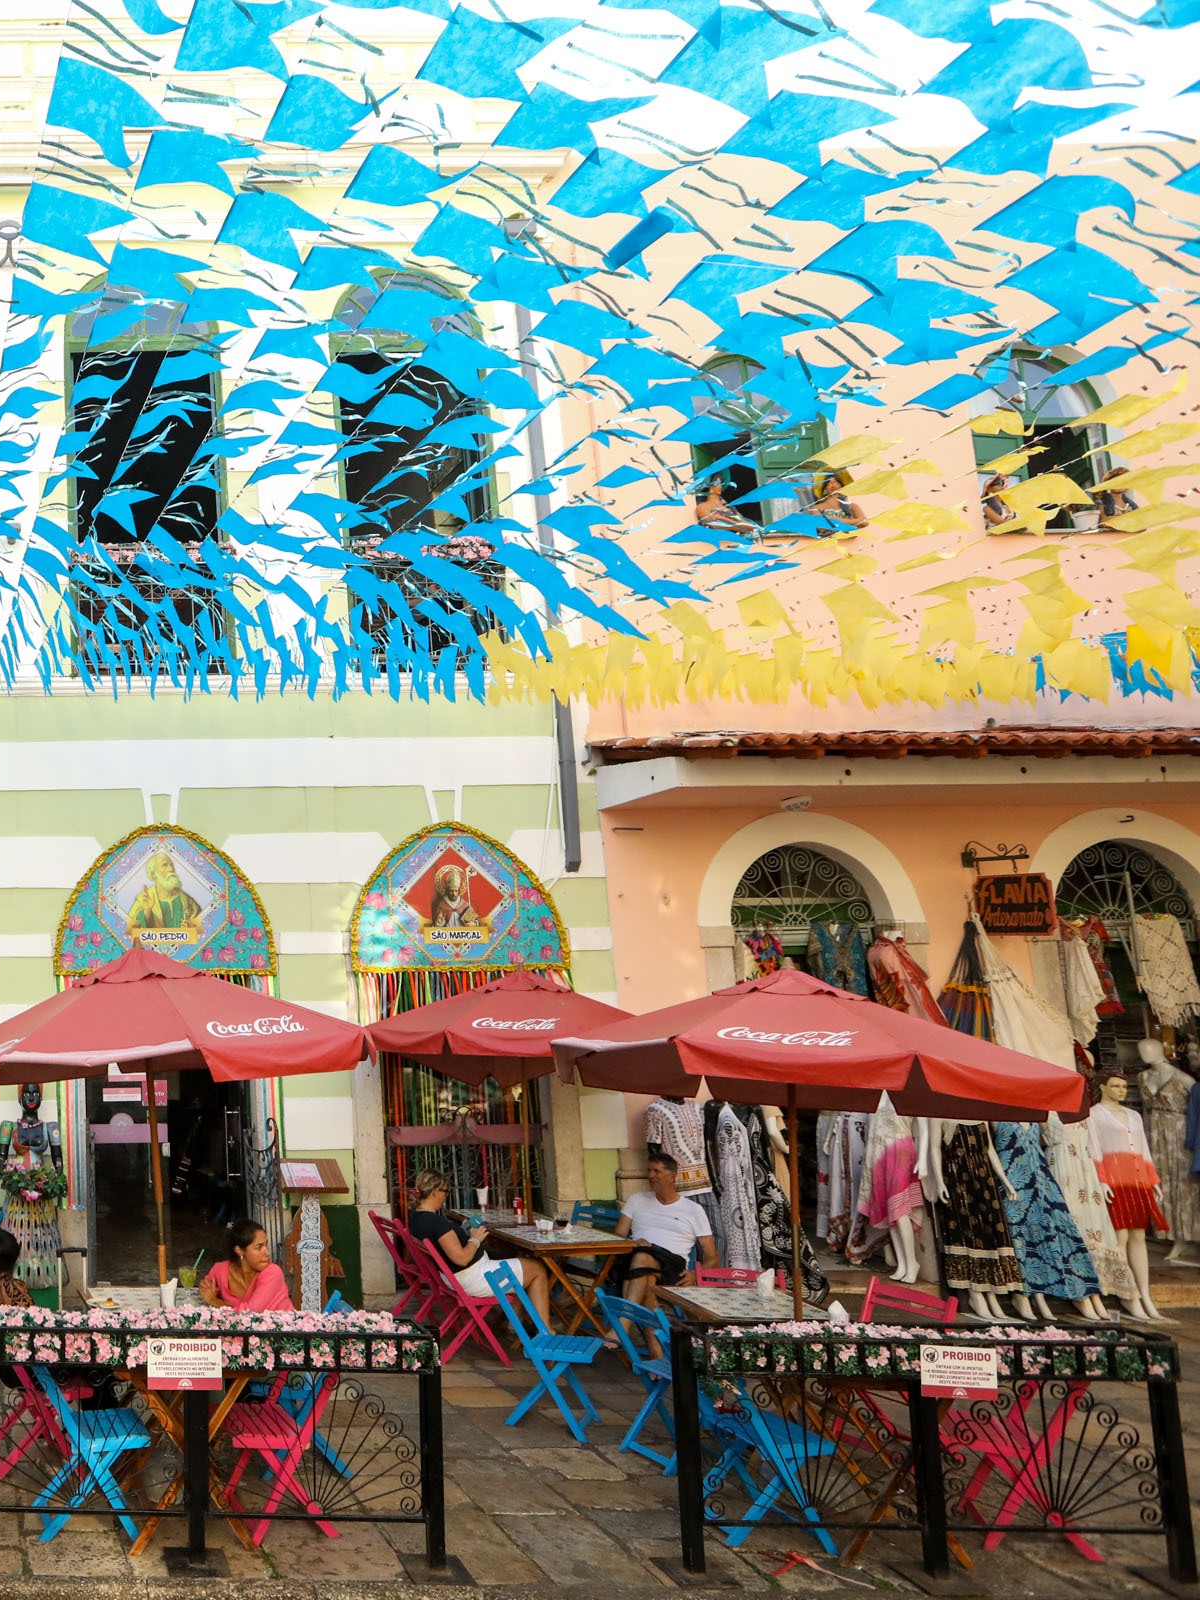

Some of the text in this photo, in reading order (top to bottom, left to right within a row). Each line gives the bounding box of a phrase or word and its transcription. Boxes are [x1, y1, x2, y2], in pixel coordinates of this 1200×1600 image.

[142, 932, 188, 940] SÃO PEDRO
[432, 930, 447, 940] SÃO
[206, 1014, 304, 1038] Coca-Cola
[472, 1017, 560, 1030] Coca-Cola
[717, 1026, 860, 1046] Coca-Cola
[169, 1343, 217, 1352] PROIBIDO
[942, 1351, 991, 1362] PROIBIDO
